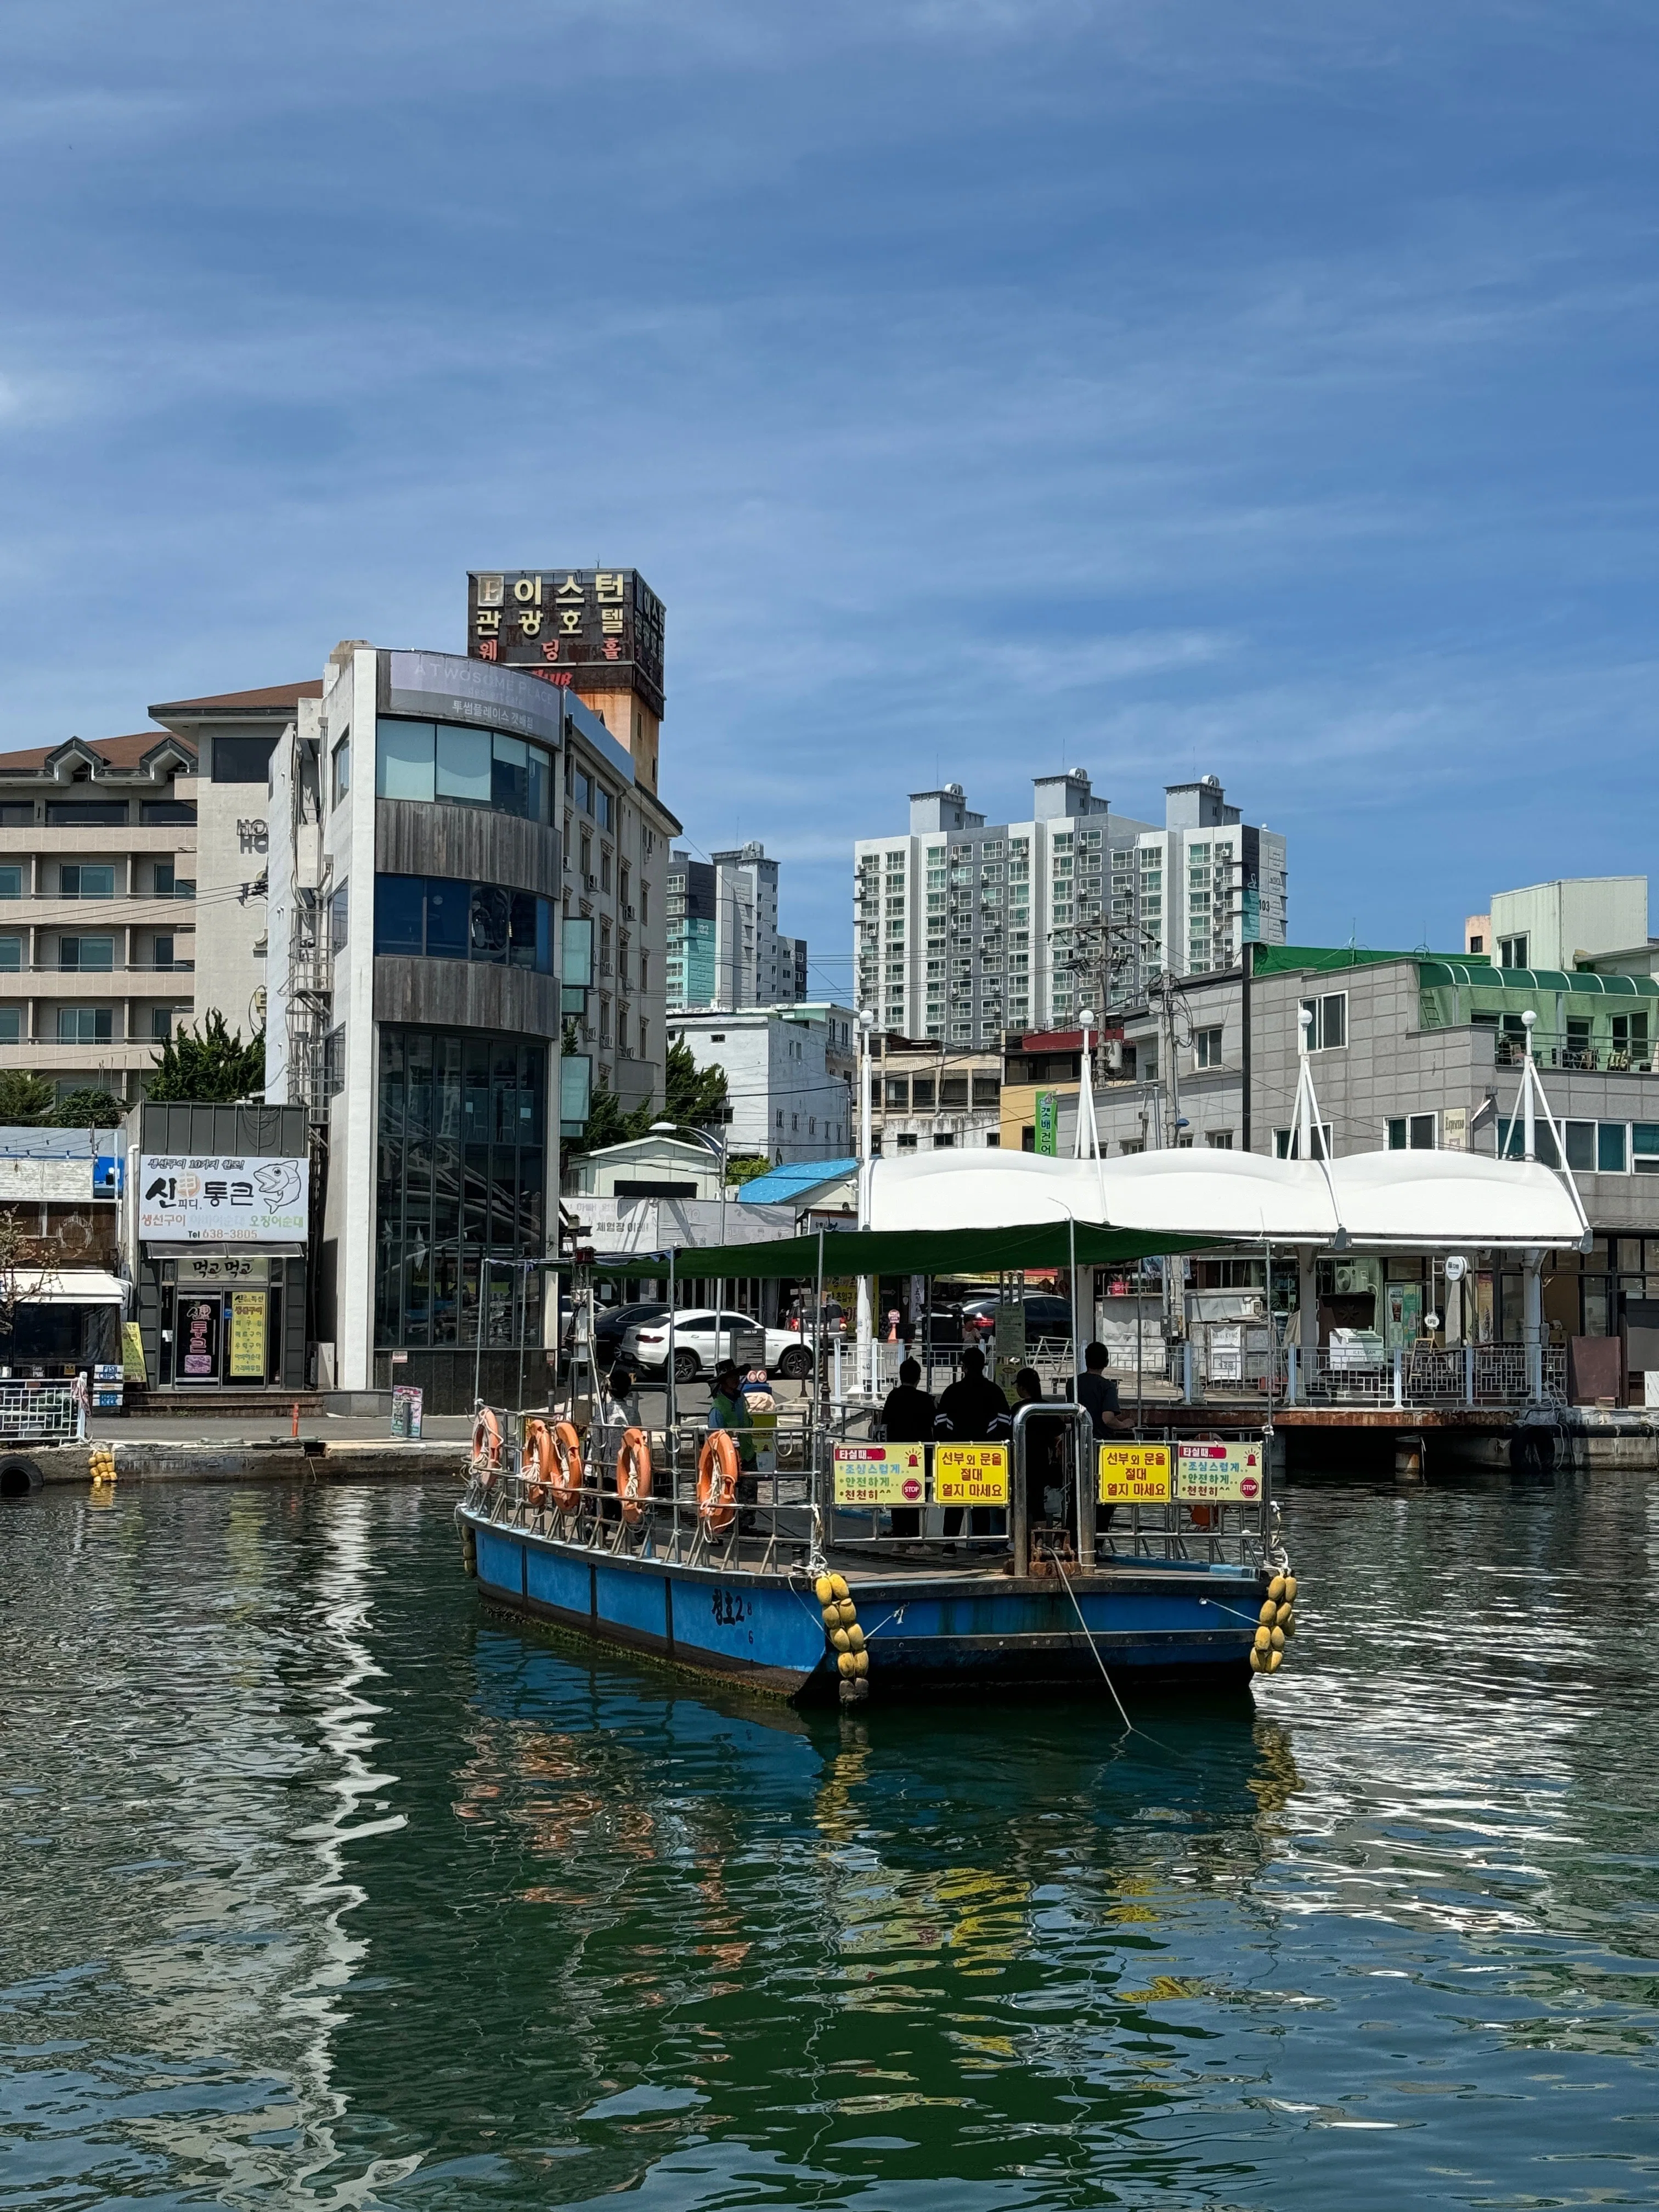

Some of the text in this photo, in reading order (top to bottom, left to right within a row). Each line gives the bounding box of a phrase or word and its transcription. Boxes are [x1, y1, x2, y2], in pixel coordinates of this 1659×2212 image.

[514, 573, 624, 606] 이스턴
[476, 608, 624, 636] 관광호텔
[518, 682, 552, 705] PLACE
[1259, 899, 1270, 912] 103
[189, 1159, 219, 1170] 10가지
[203, 1181, 254, 1207] 통큰
[142, 1214, 186, 1227] 생선구이
[249, 1214, 304, 1228] 오징어순대
[188, 1229, 257, 1239] Tel 638-3805
[980, 1453, 1002, 1466] 문을
[1144, 1453, 1166, 1466] 문을
[961, 1468, 983, 1481] 절대
[1125, 1468, 1147, 1481] 절대
[942, 1483, 1002, 1497] 열지 마세요
[1107, 1483, 1166, 1496] 열지 마세요
